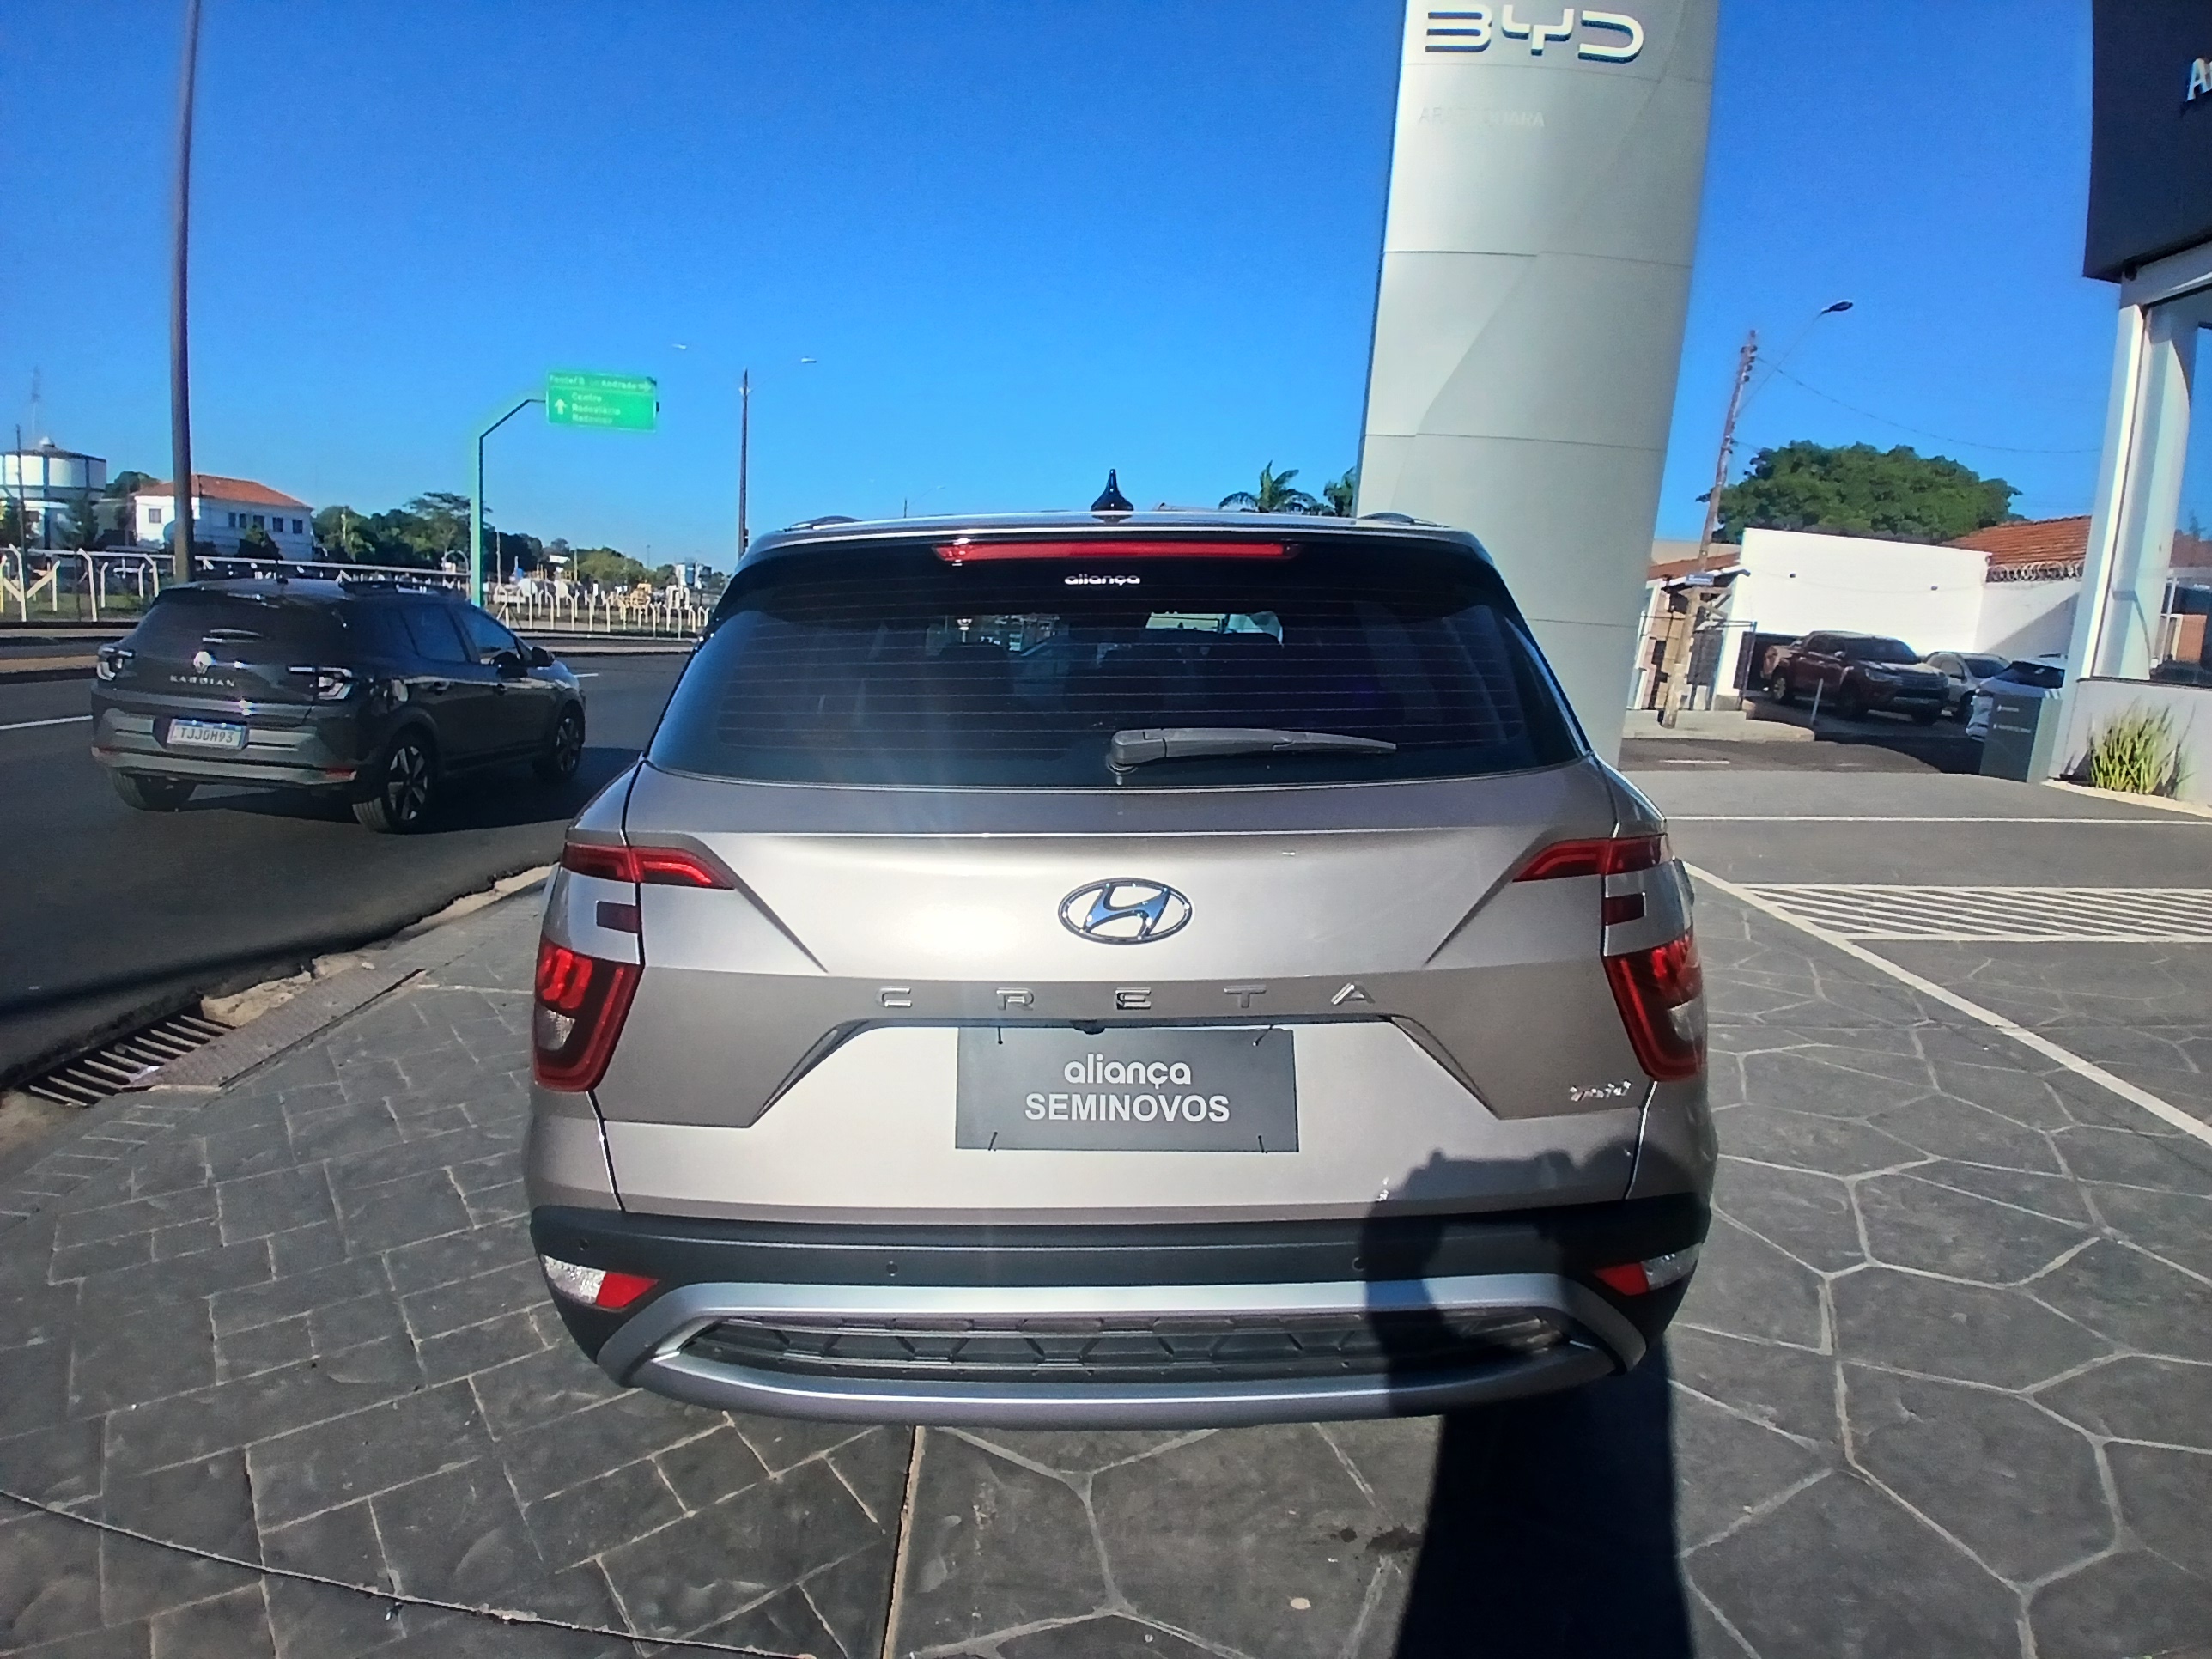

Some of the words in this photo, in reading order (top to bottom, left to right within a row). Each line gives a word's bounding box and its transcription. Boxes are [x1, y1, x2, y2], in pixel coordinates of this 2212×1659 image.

[1425, 4, 1644, 63] BYD
[874, 982, 1375, 1012] CRETA
[1064, 1053, 1192, 1090] aliança
[1024, 1092, 1230, 1123] SEMINOVOS
